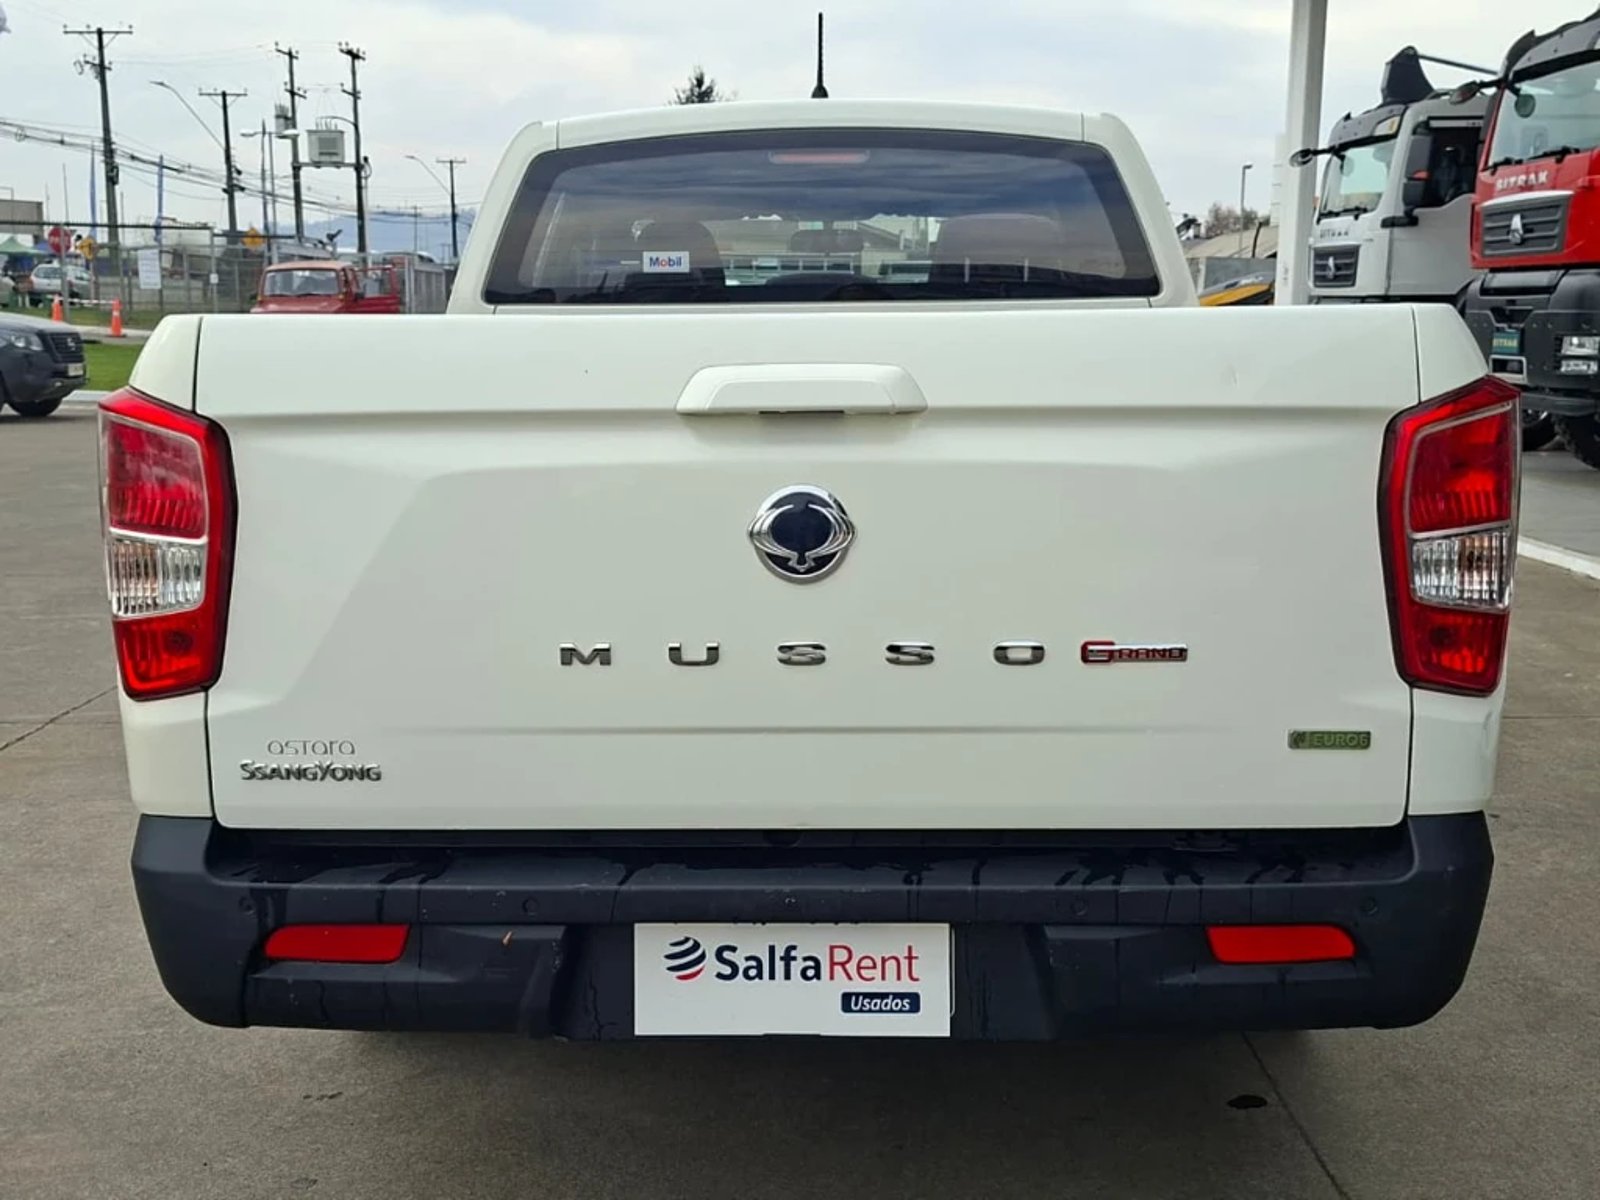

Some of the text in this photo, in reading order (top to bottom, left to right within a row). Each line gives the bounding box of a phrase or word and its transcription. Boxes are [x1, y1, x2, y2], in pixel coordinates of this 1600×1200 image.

[649, 256, 682, 267] Mobil
[559, 641, 1045, 666] MUSSO
[267, 740, 355, 755] astara
[714, 945, 921, 982] SalfaRent
[851, 995, 911, 1011] Usados
